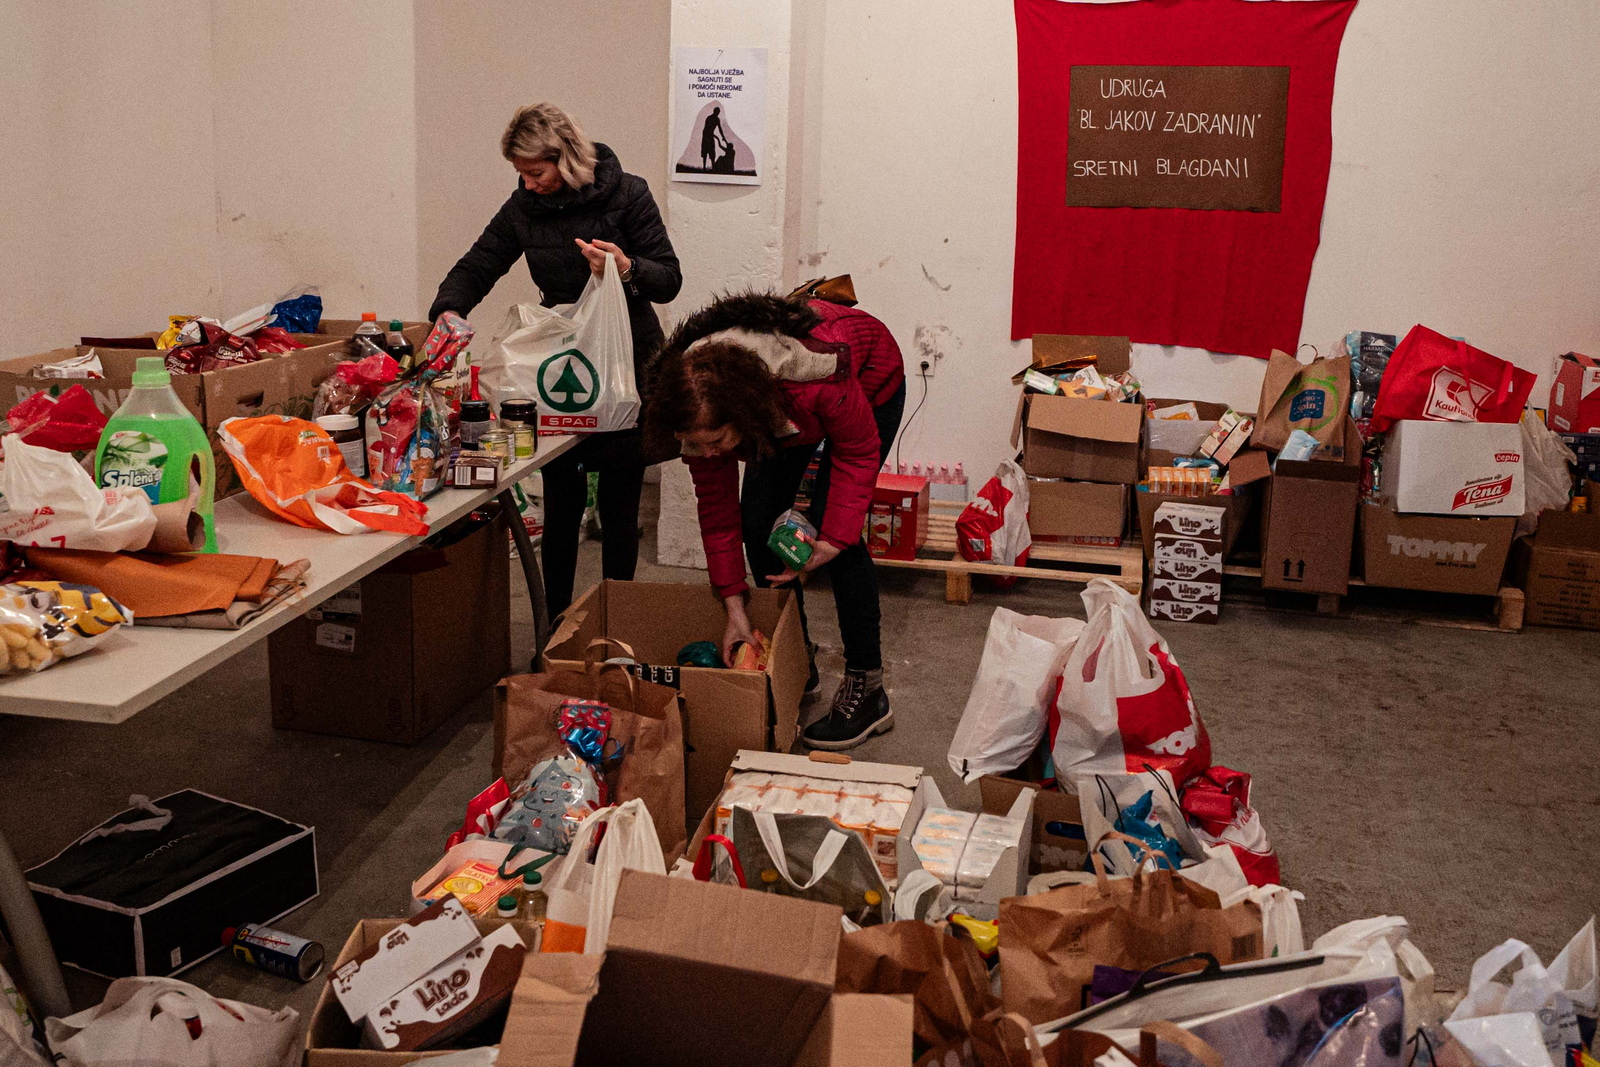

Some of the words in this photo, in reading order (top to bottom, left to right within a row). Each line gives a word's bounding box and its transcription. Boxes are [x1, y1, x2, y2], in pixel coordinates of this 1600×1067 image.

[1100, 78, 1167, 98] UDRUGA
[1104, 110, 1156, 131] JAKOV
[1073, 159, 1138, 177] SRETNI
[1156, 158, 1248, 178] BLAGDANI
[549, 417, 596, 427] SPAR
[1464, 485, 1503, 503] Tena
[1179, 517, 1202, 528] Lino
[1174, 547, 1197, 558] Lino
[1387, 535, 1487, 562] TOMMY
[1174, 562, 1197, 574] Lino
[1178, 584, 1200, 595] Lino
[1170, 604, 1193, 615] Lino
[412, 969, 470, 1011] Lino
[435, 990, 469, 1017] Lada
